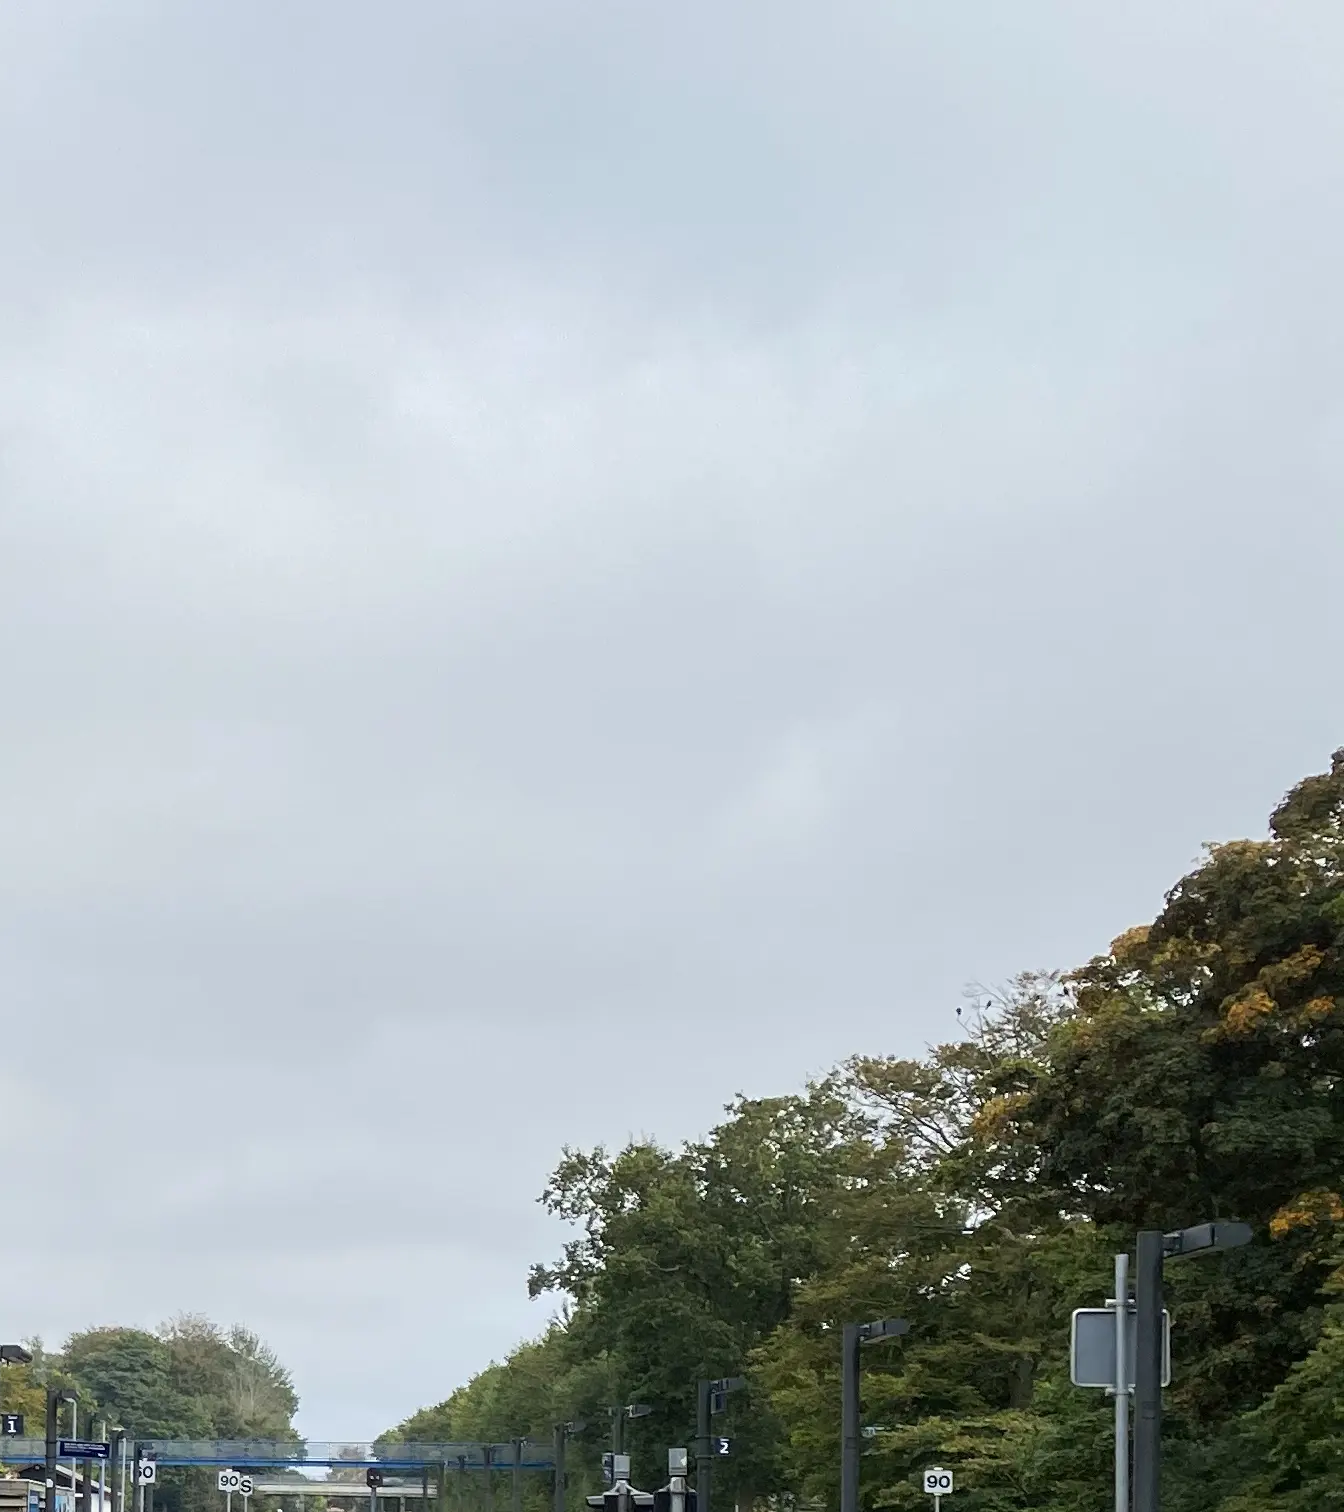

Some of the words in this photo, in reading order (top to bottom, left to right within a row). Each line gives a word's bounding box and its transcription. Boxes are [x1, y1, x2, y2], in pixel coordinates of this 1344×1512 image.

[7, 1420, 17, 1433] 1
[719, 1442, 729, 1454] 2
[220, 1475, 239, 1487] 90
[240, 1479, 252, 1493] S
[926, 1475, 951, 1489] 90
